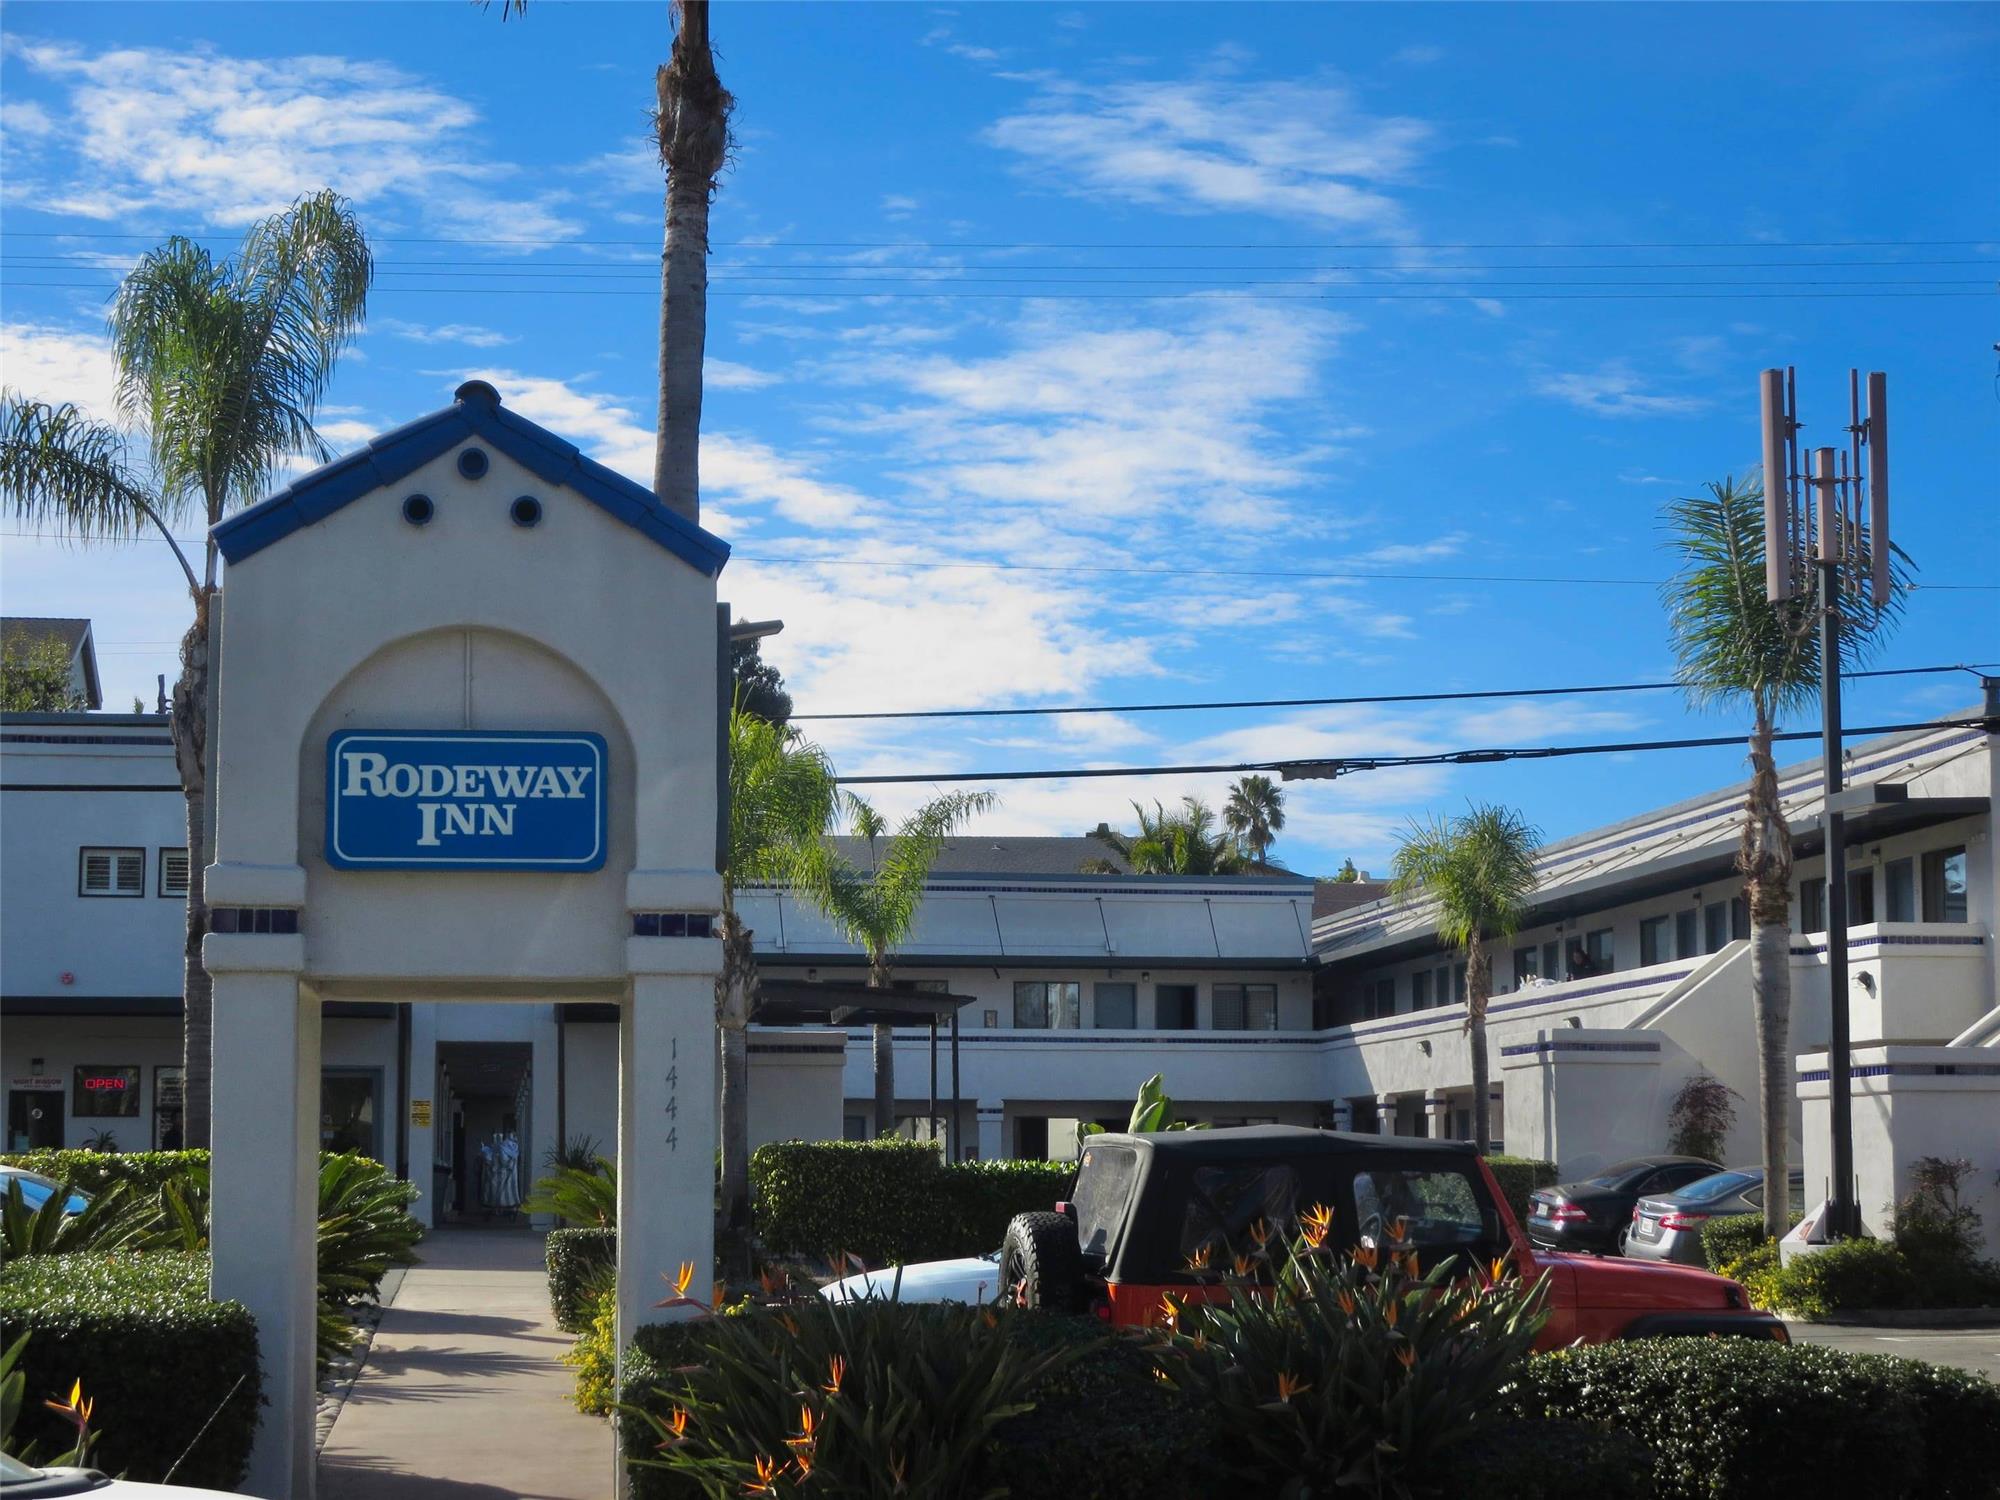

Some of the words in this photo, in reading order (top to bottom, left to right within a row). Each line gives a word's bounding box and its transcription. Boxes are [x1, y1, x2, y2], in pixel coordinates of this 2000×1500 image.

[342, 752, 592, 799] RODEWAY
[416, 803, 517, 846] INN
[85, 1078, 125, 1089] OPEN
[665, 1037, 678, 1153] 1444
